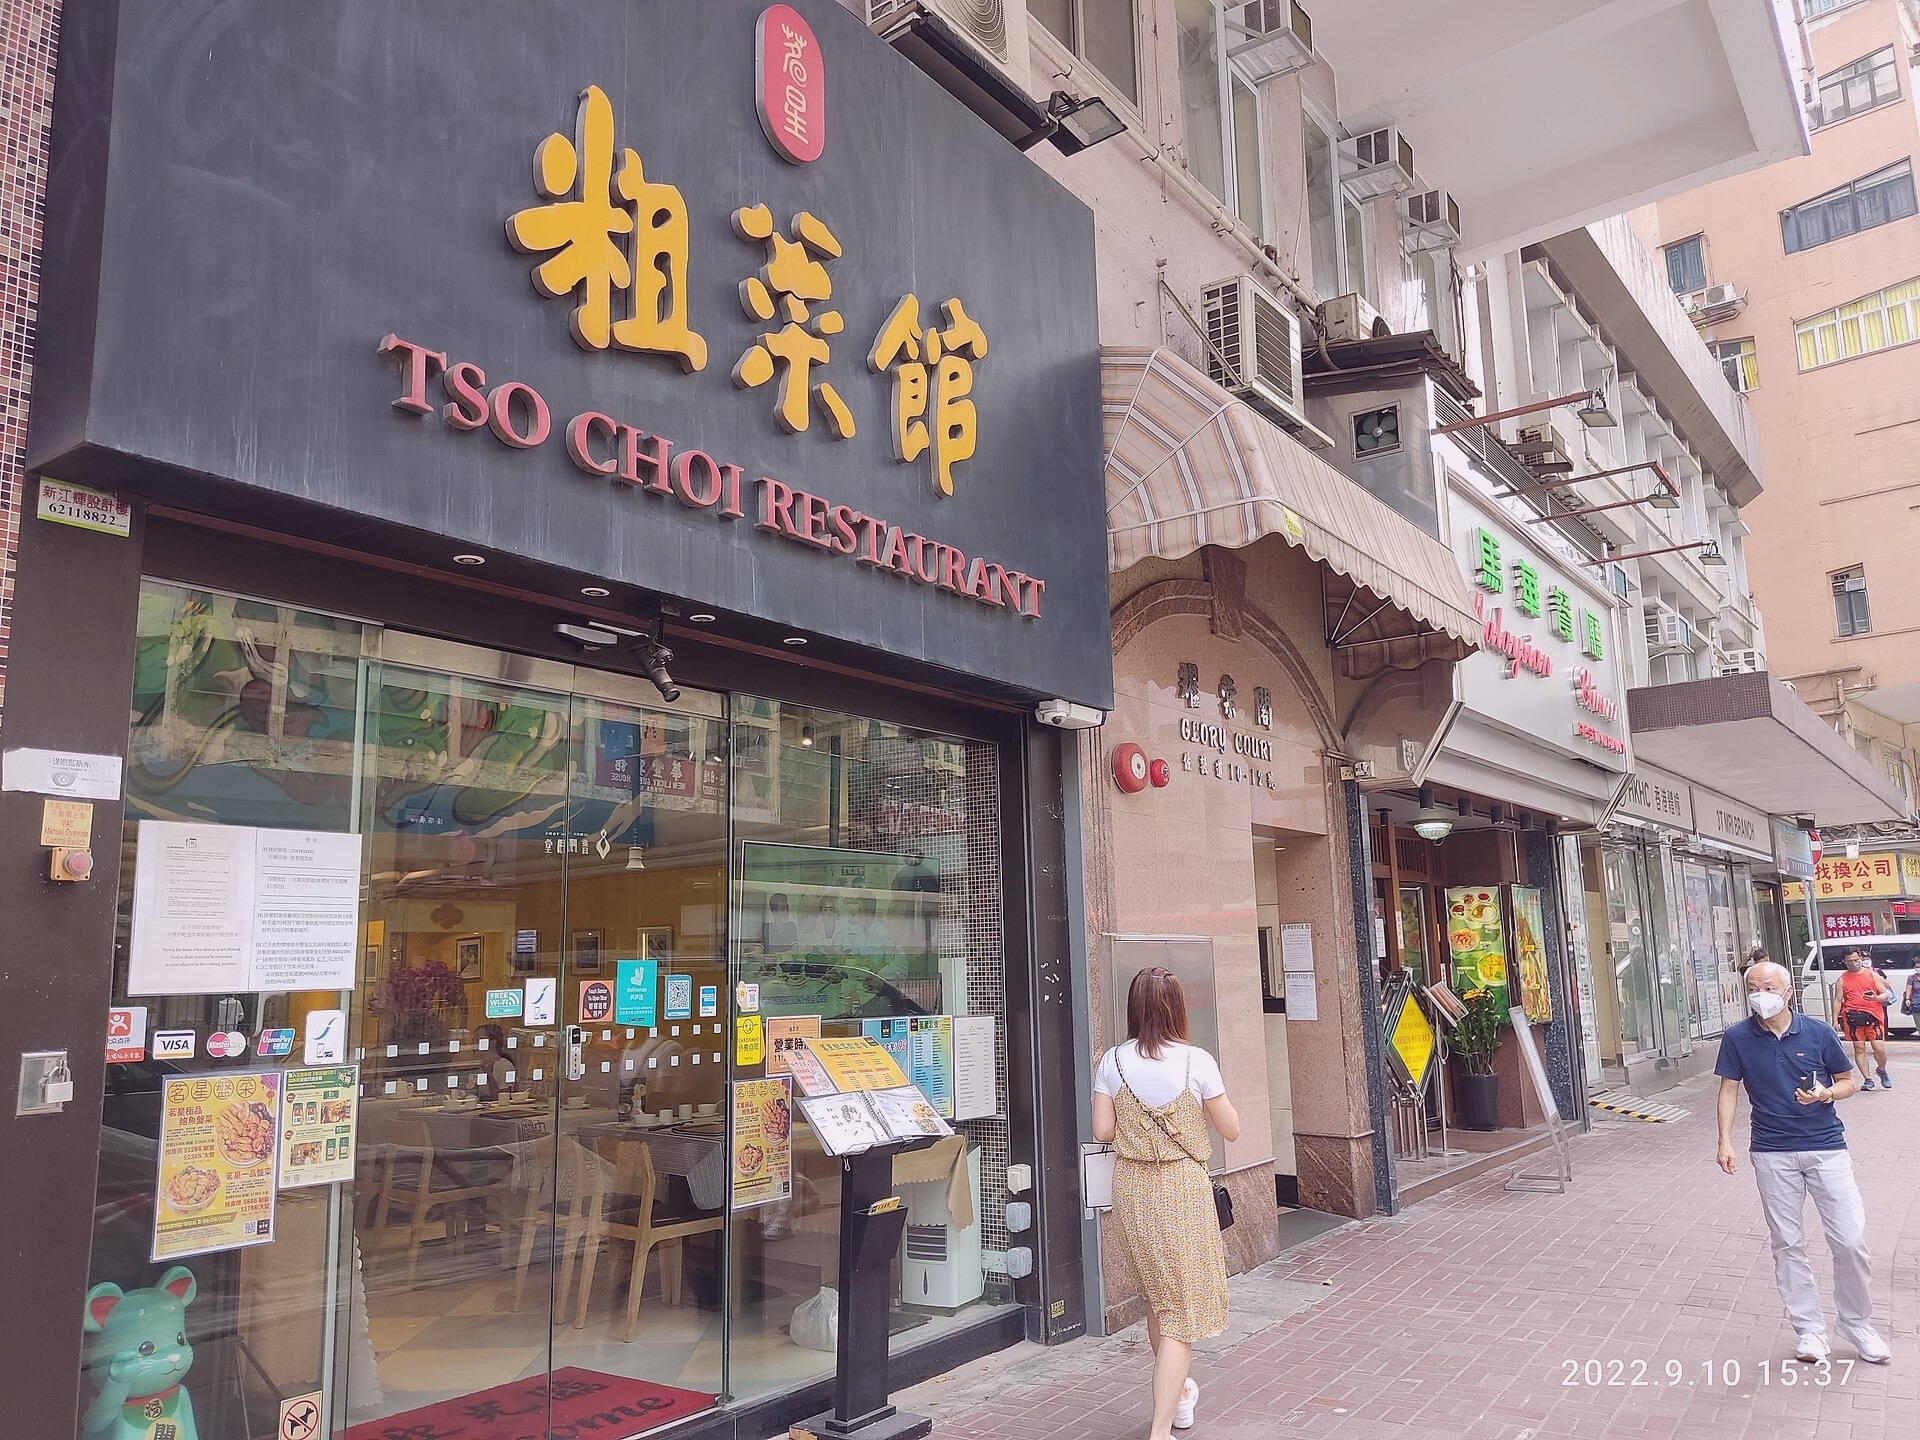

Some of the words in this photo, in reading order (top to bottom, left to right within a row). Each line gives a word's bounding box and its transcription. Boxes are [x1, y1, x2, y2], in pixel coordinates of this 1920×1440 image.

[505, 85, 988, 498] 粗菜館
[378, 333, 551, 449] TSO
[565, 411, 746, 520] CHOI
[755, 476, 1046, 619] RESTAURANT
[49, 502, 116, 526] 62118822
[1472, 526, 1604, 662] 馬華餐廳
[1180, 718, 1227, 754] GLORY
[1234, 732, 1273, 762] COURT
[1815, 858, 1892, 880] 找換公司
[1825, 915, 1872, 928] 泰安找換
[490, 991, 509, 999] FREE
[490, 999, 509, 1007] WI-FI
[162, 1040, 190, 1050] VISA
